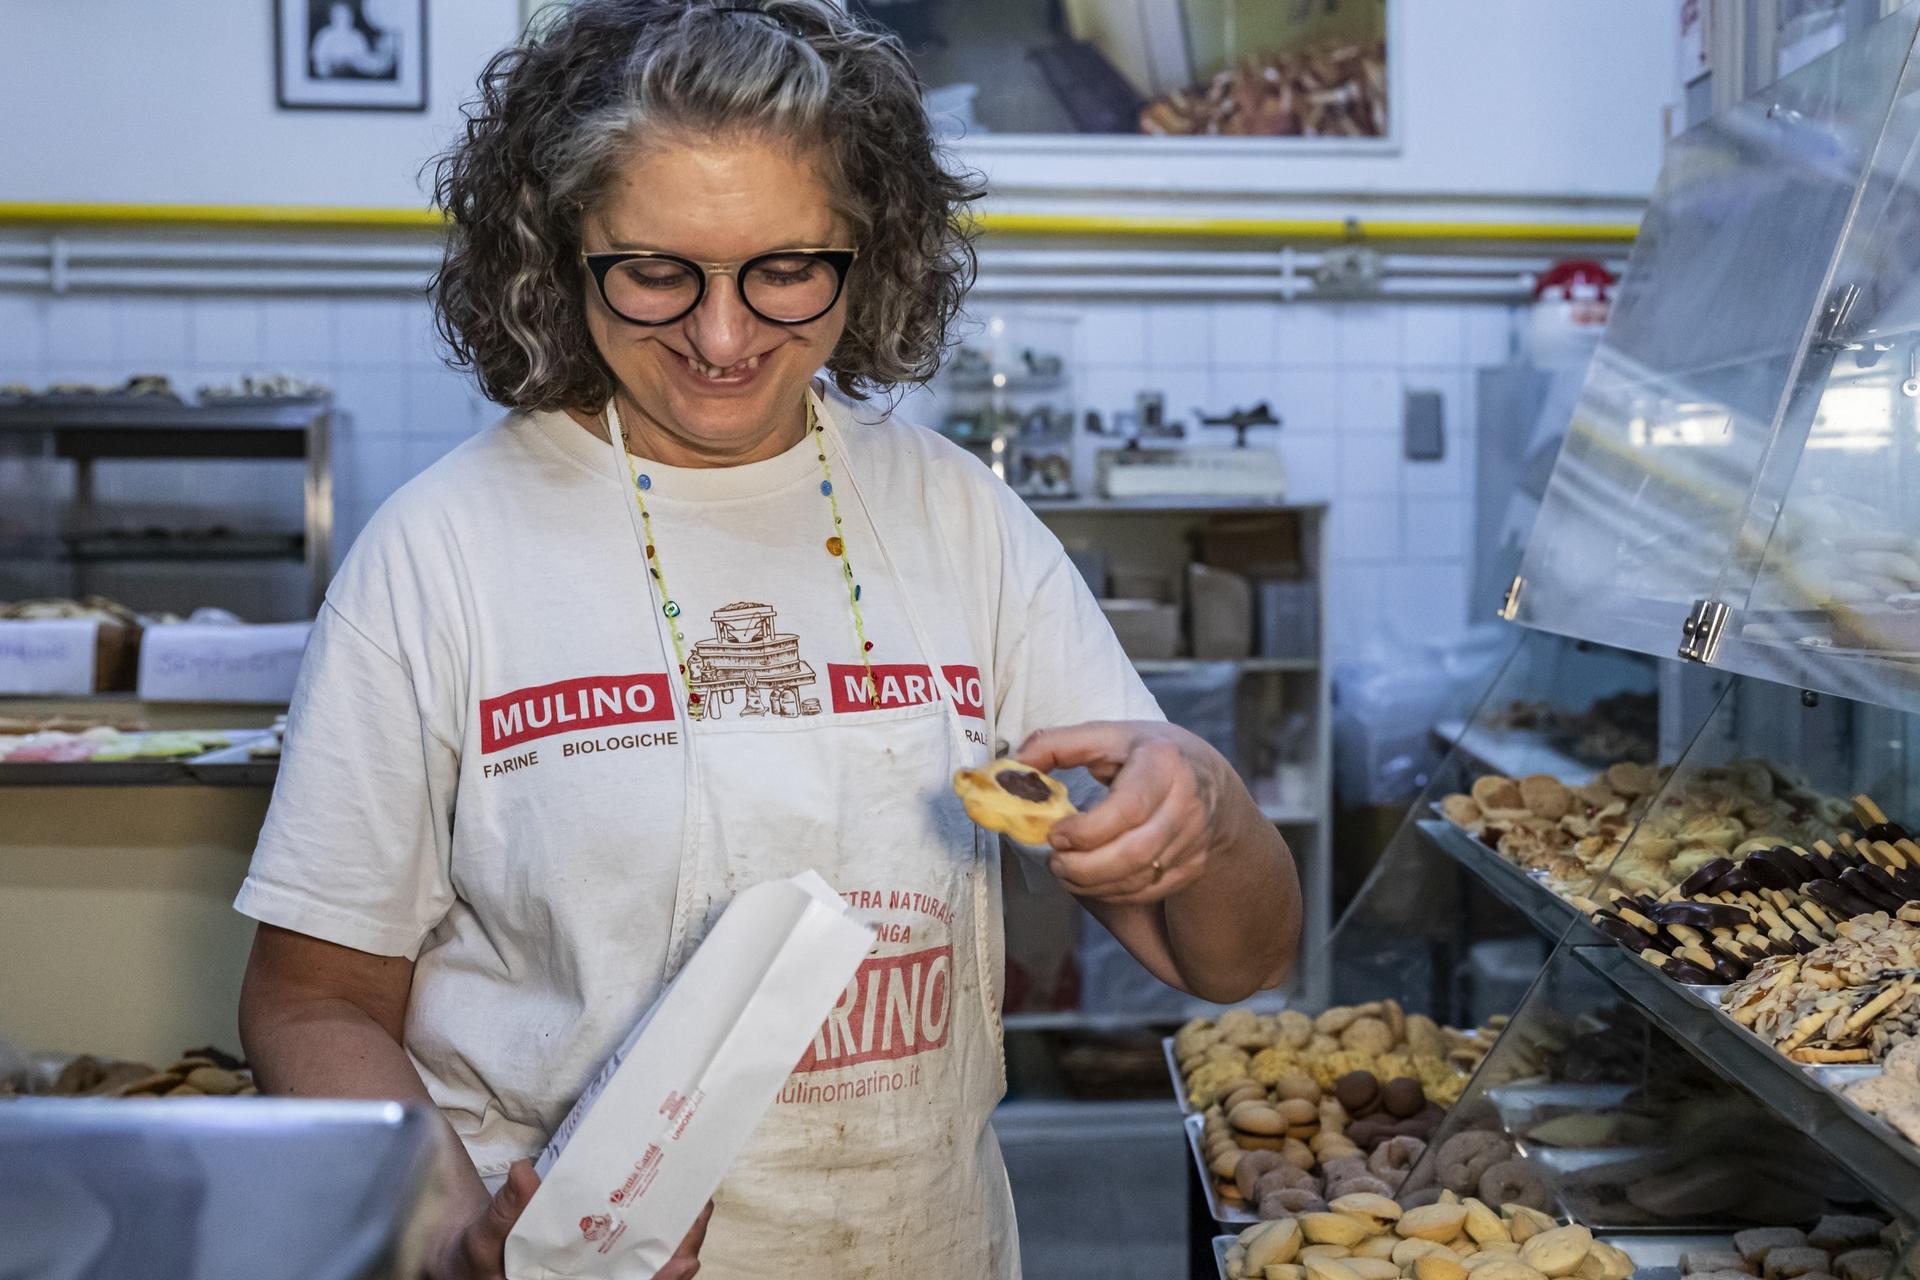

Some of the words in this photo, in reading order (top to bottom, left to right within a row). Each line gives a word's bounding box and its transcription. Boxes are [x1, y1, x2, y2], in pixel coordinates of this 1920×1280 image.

[491, 684, 656, 741] MULINO
[483, 751, 539, 779] FARINE
[562, 731, 679, 758] BIOLOGICHE
[876, 923, 911, 944] NGA
[775, 1063, 921, 1105] ulinomarino.it
